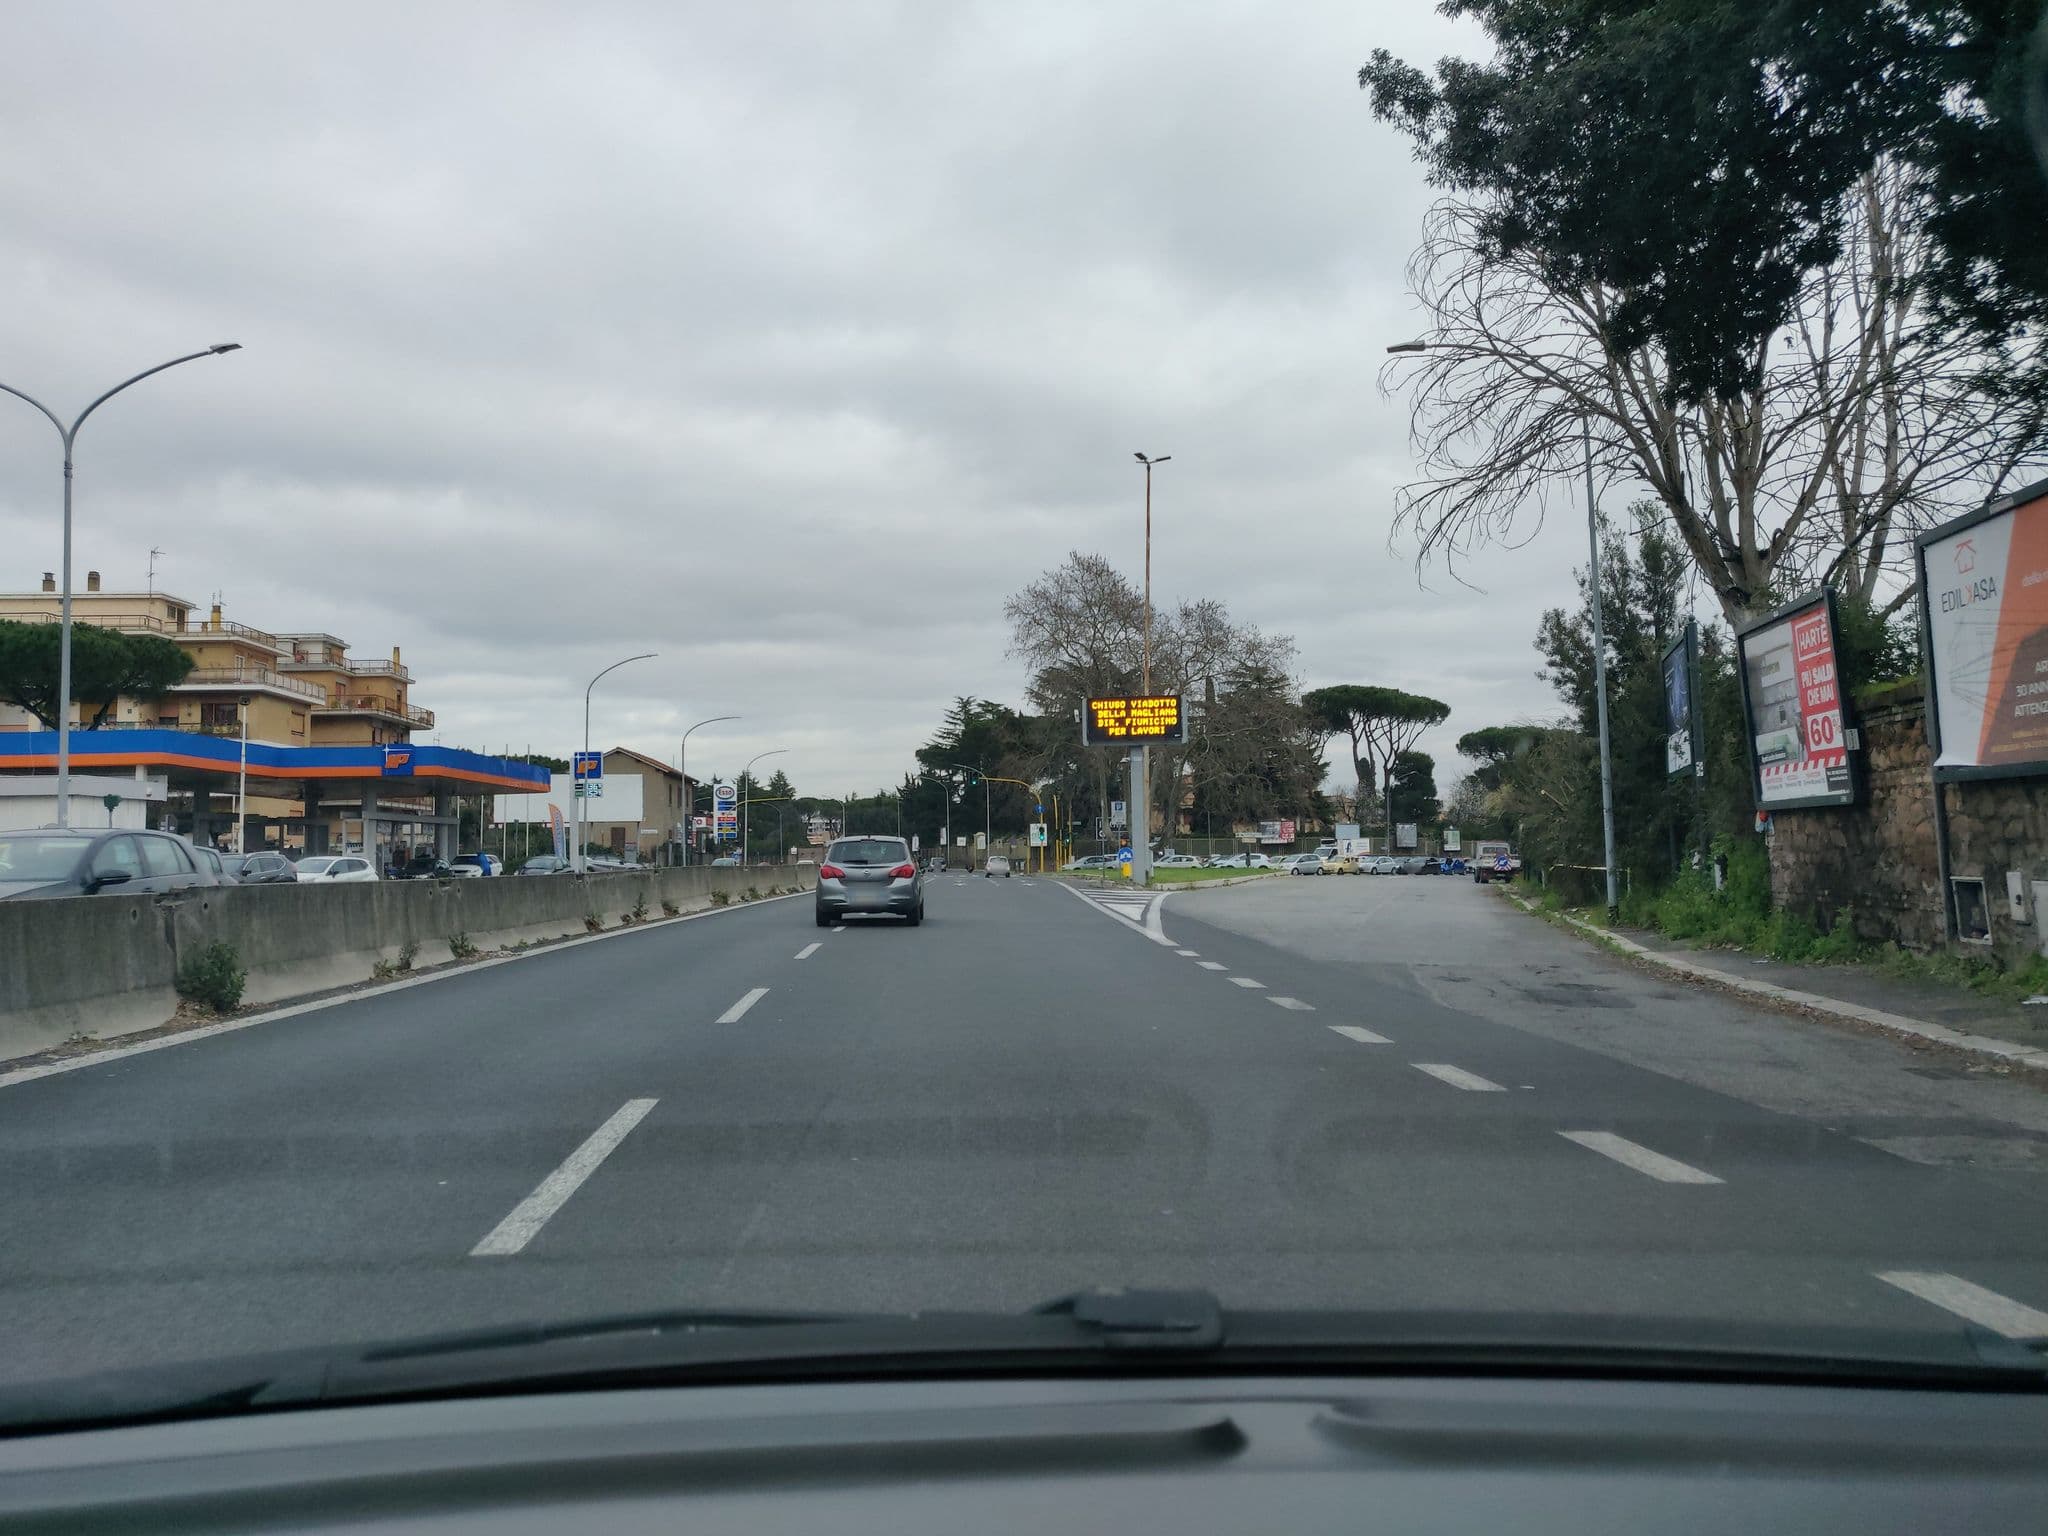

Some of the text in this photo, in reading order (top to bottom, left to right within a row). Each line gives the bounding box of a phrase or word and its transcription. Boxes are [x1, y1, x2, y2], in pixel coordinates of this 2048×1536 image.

[1091, 699, 1177, 710] CHIUSO VIADOTTO
[1097, 708, 1177, 718] DELLA MAGLIANA
[1097, 717, 1178, 727] DIR. FIUMICINO
[1109, 726, 1166, 736] PER LAVORI
